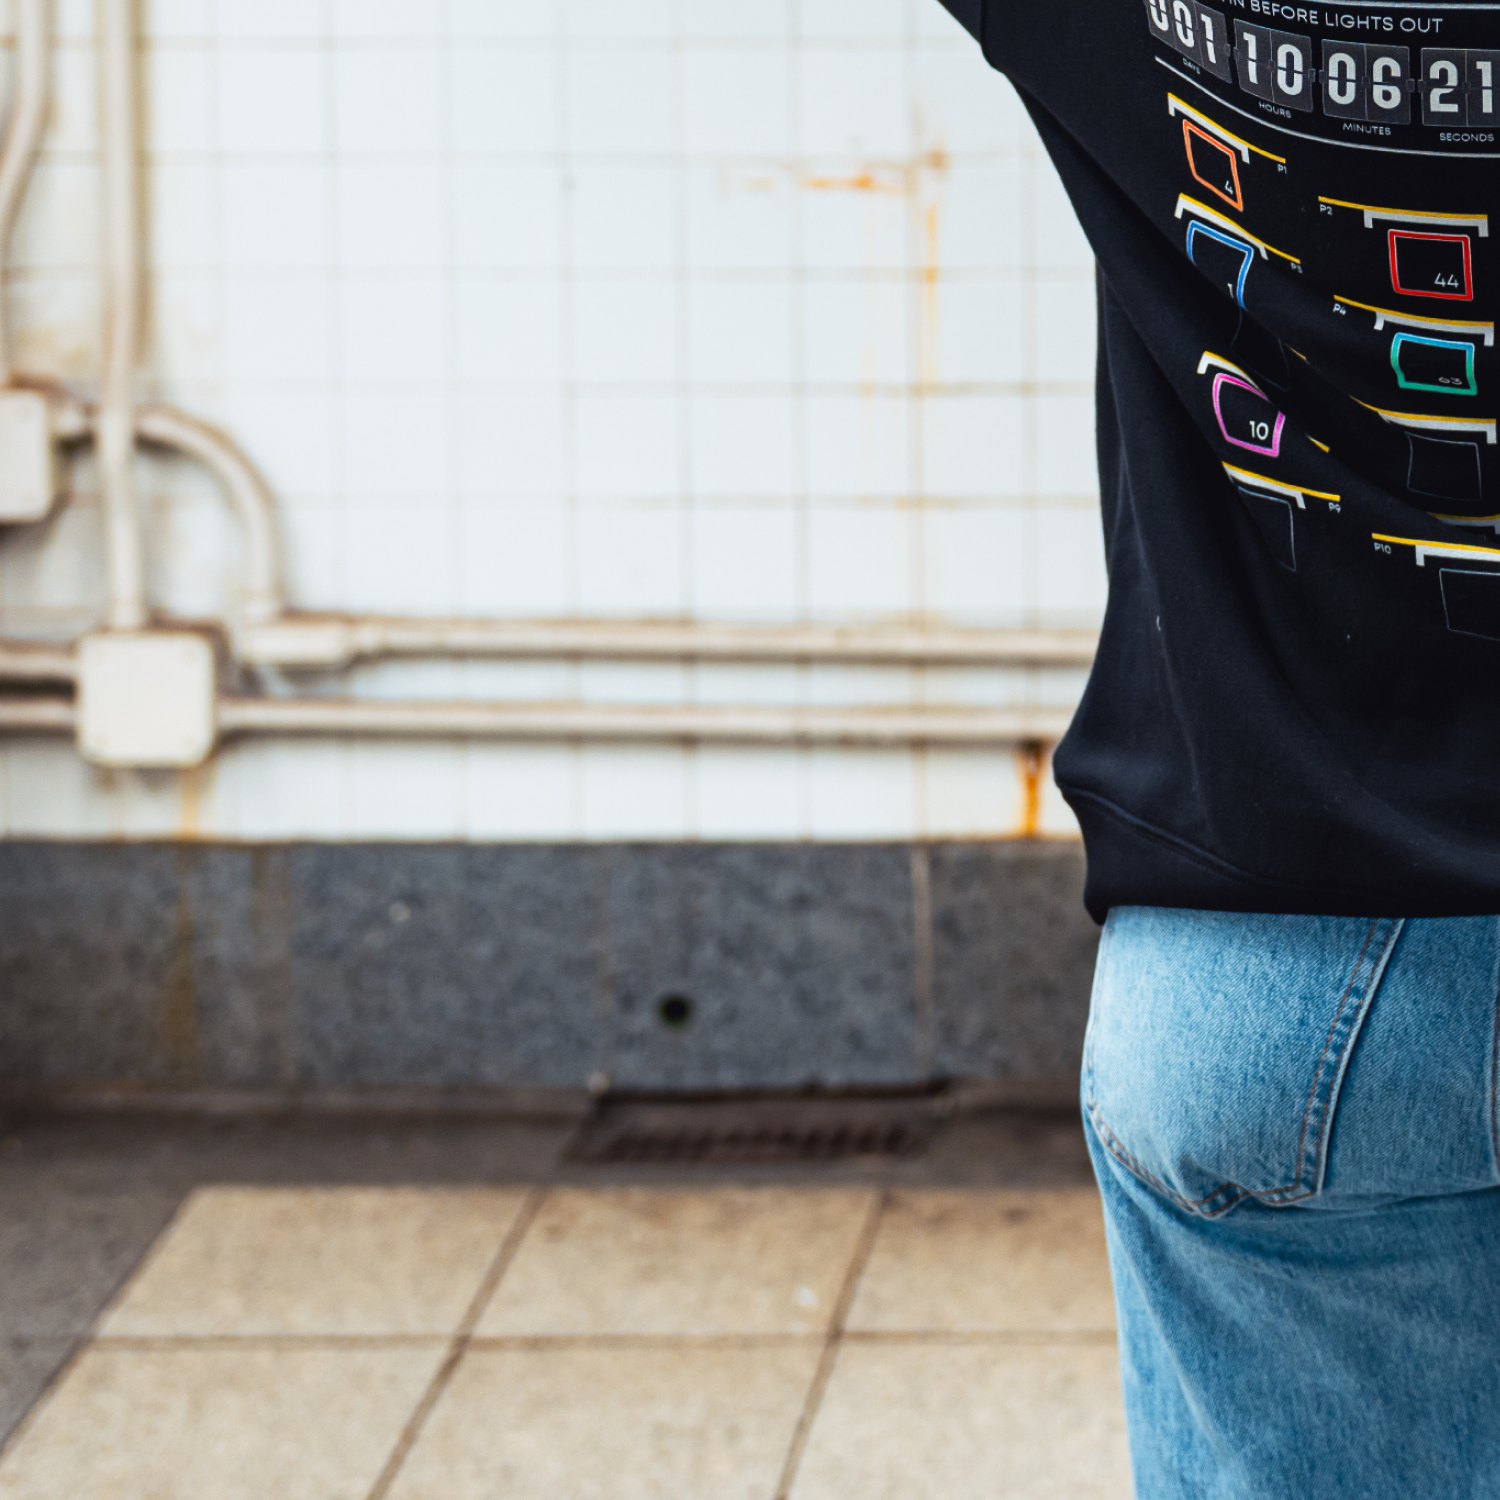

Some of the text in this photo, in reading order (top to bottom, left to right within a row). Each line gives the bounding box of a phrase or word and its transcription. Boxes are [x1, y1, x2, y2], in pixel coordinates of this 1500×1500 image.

[1325, 12, 1394, 31] LIGHTS
[1400, 17, 1443, 33] OUT
[1243, 31, 1303, 96] 10
[1328, 52, 1401, 110] 06
[1429, 60, 1493, 114] 21
[1258, 101, 1292, 118] HOURS
[1342, 123, 1391, 136] MINUTES
[1439, 132, 1495, 142] SECONDS
[1277, 163, 1287, 174] P1
[1224, 180, 1233, 195] 4
[1319, 204, 1333, 215] P2
[1434, 273, 1459, 288] 44
[1333, 303, 1346, 315] P4
[1249, 420, 1269, 440] 10
[1328, 502, 1341, 513] P9
[1373, 542, 1391, 554] P10
